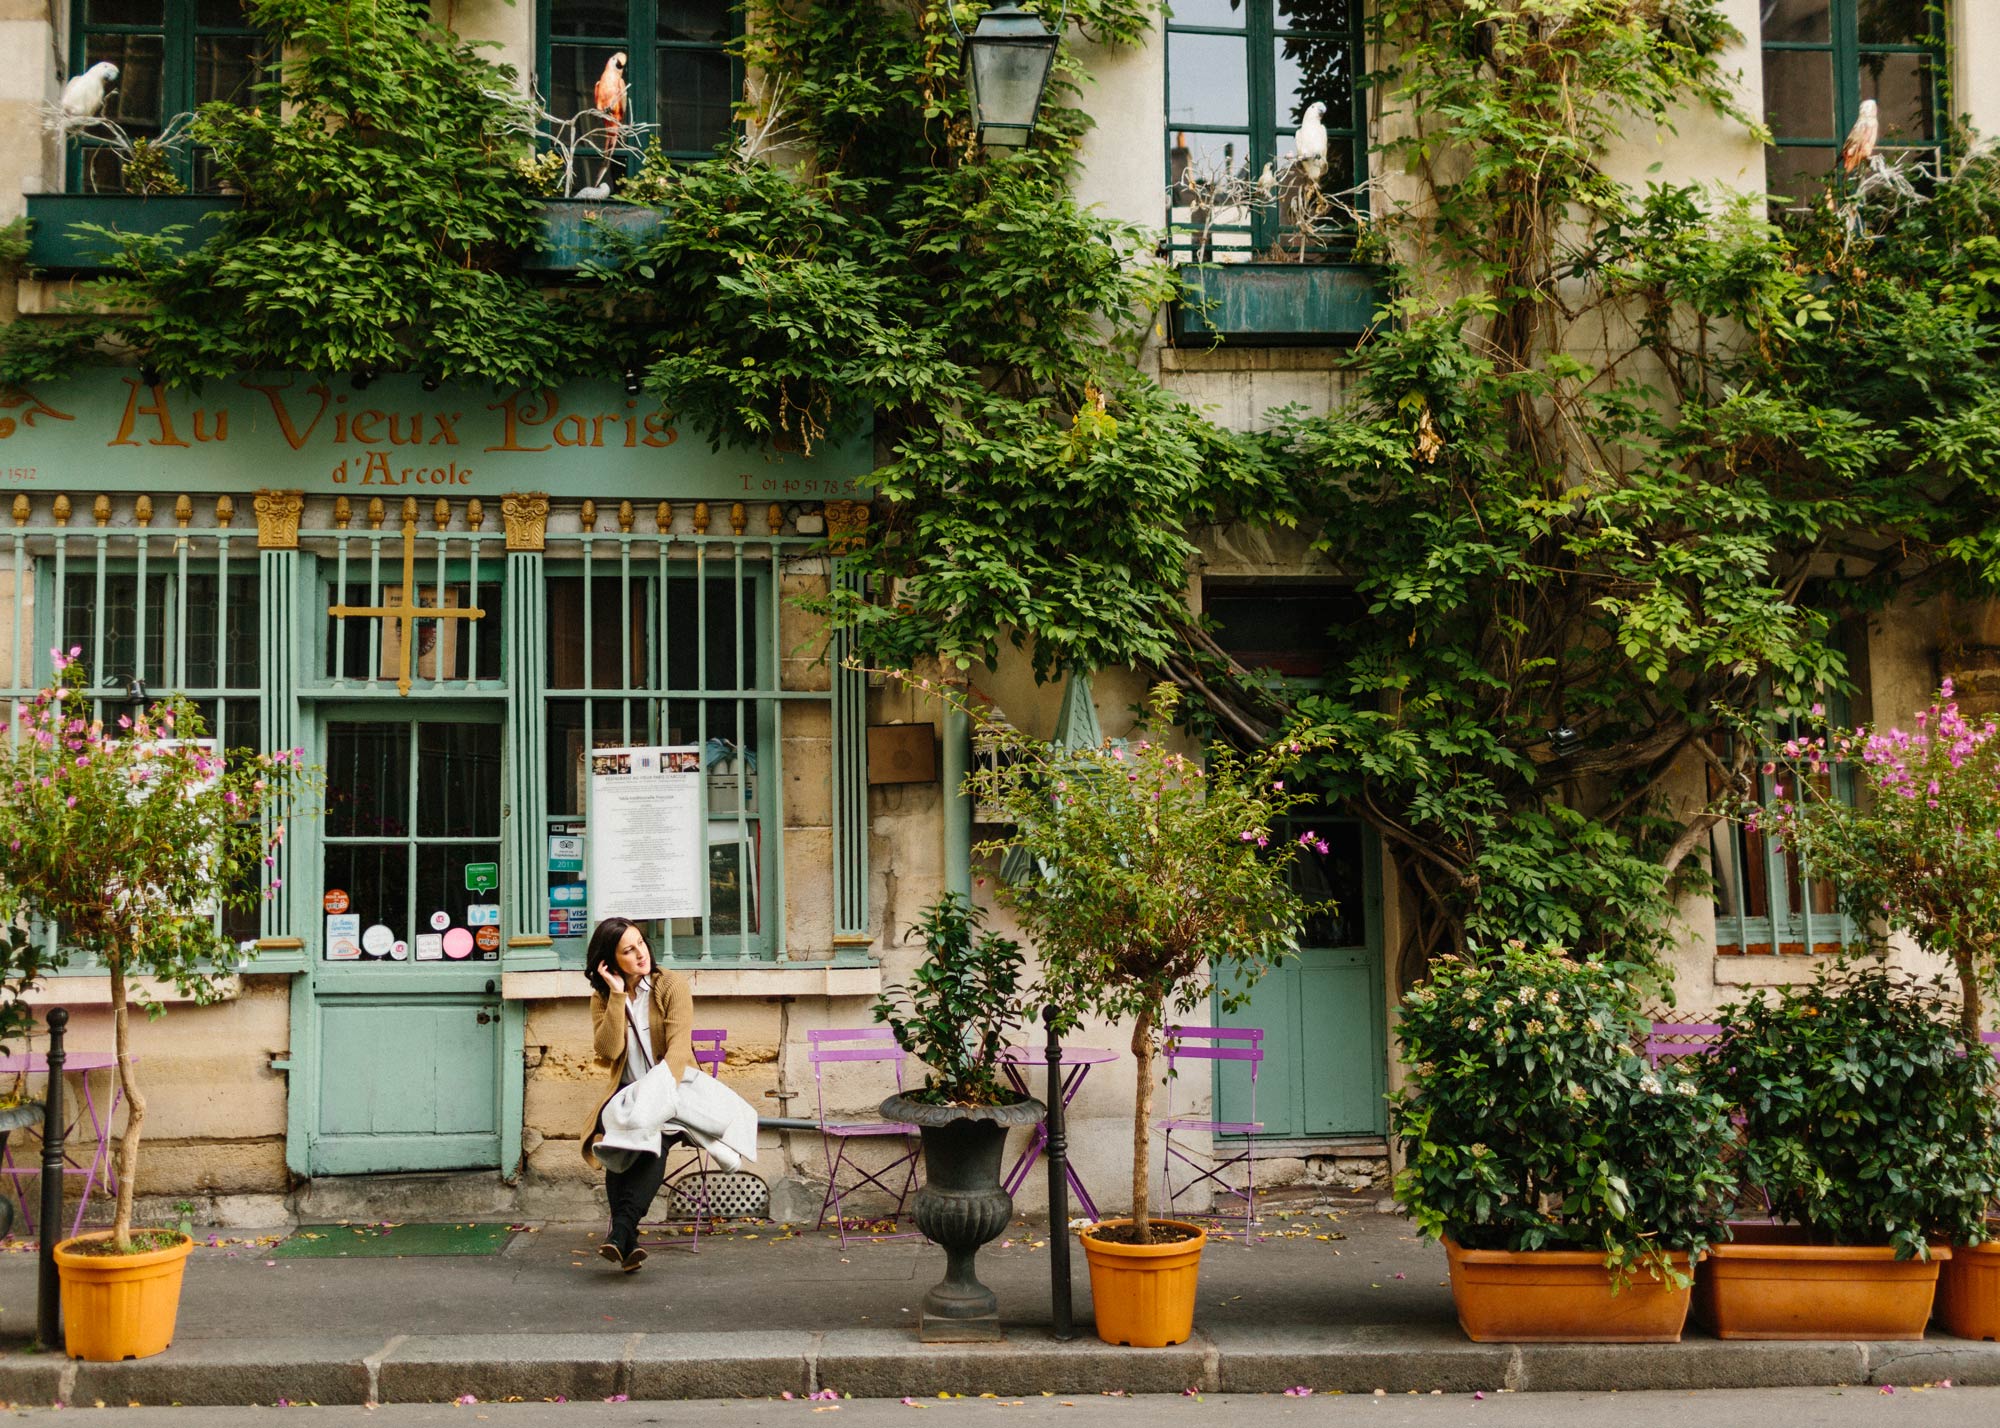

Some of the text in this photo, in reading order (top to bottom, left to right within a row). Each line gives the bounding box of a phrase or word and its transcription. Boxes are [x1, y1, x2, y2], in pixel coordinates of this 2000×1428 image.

[106, 377, 679, 453] Au Vieux Paris
[8, 467, 37, 484] 1512
[332, 451, 473, 486] d'Arcole
[761, 479, 777, 491] 01
[782, 479, 800, 495] 40
[803, 479, 818, 495] 51
[823, 479, 838, 495] 78
[557, 860, 574, 868] 2011
